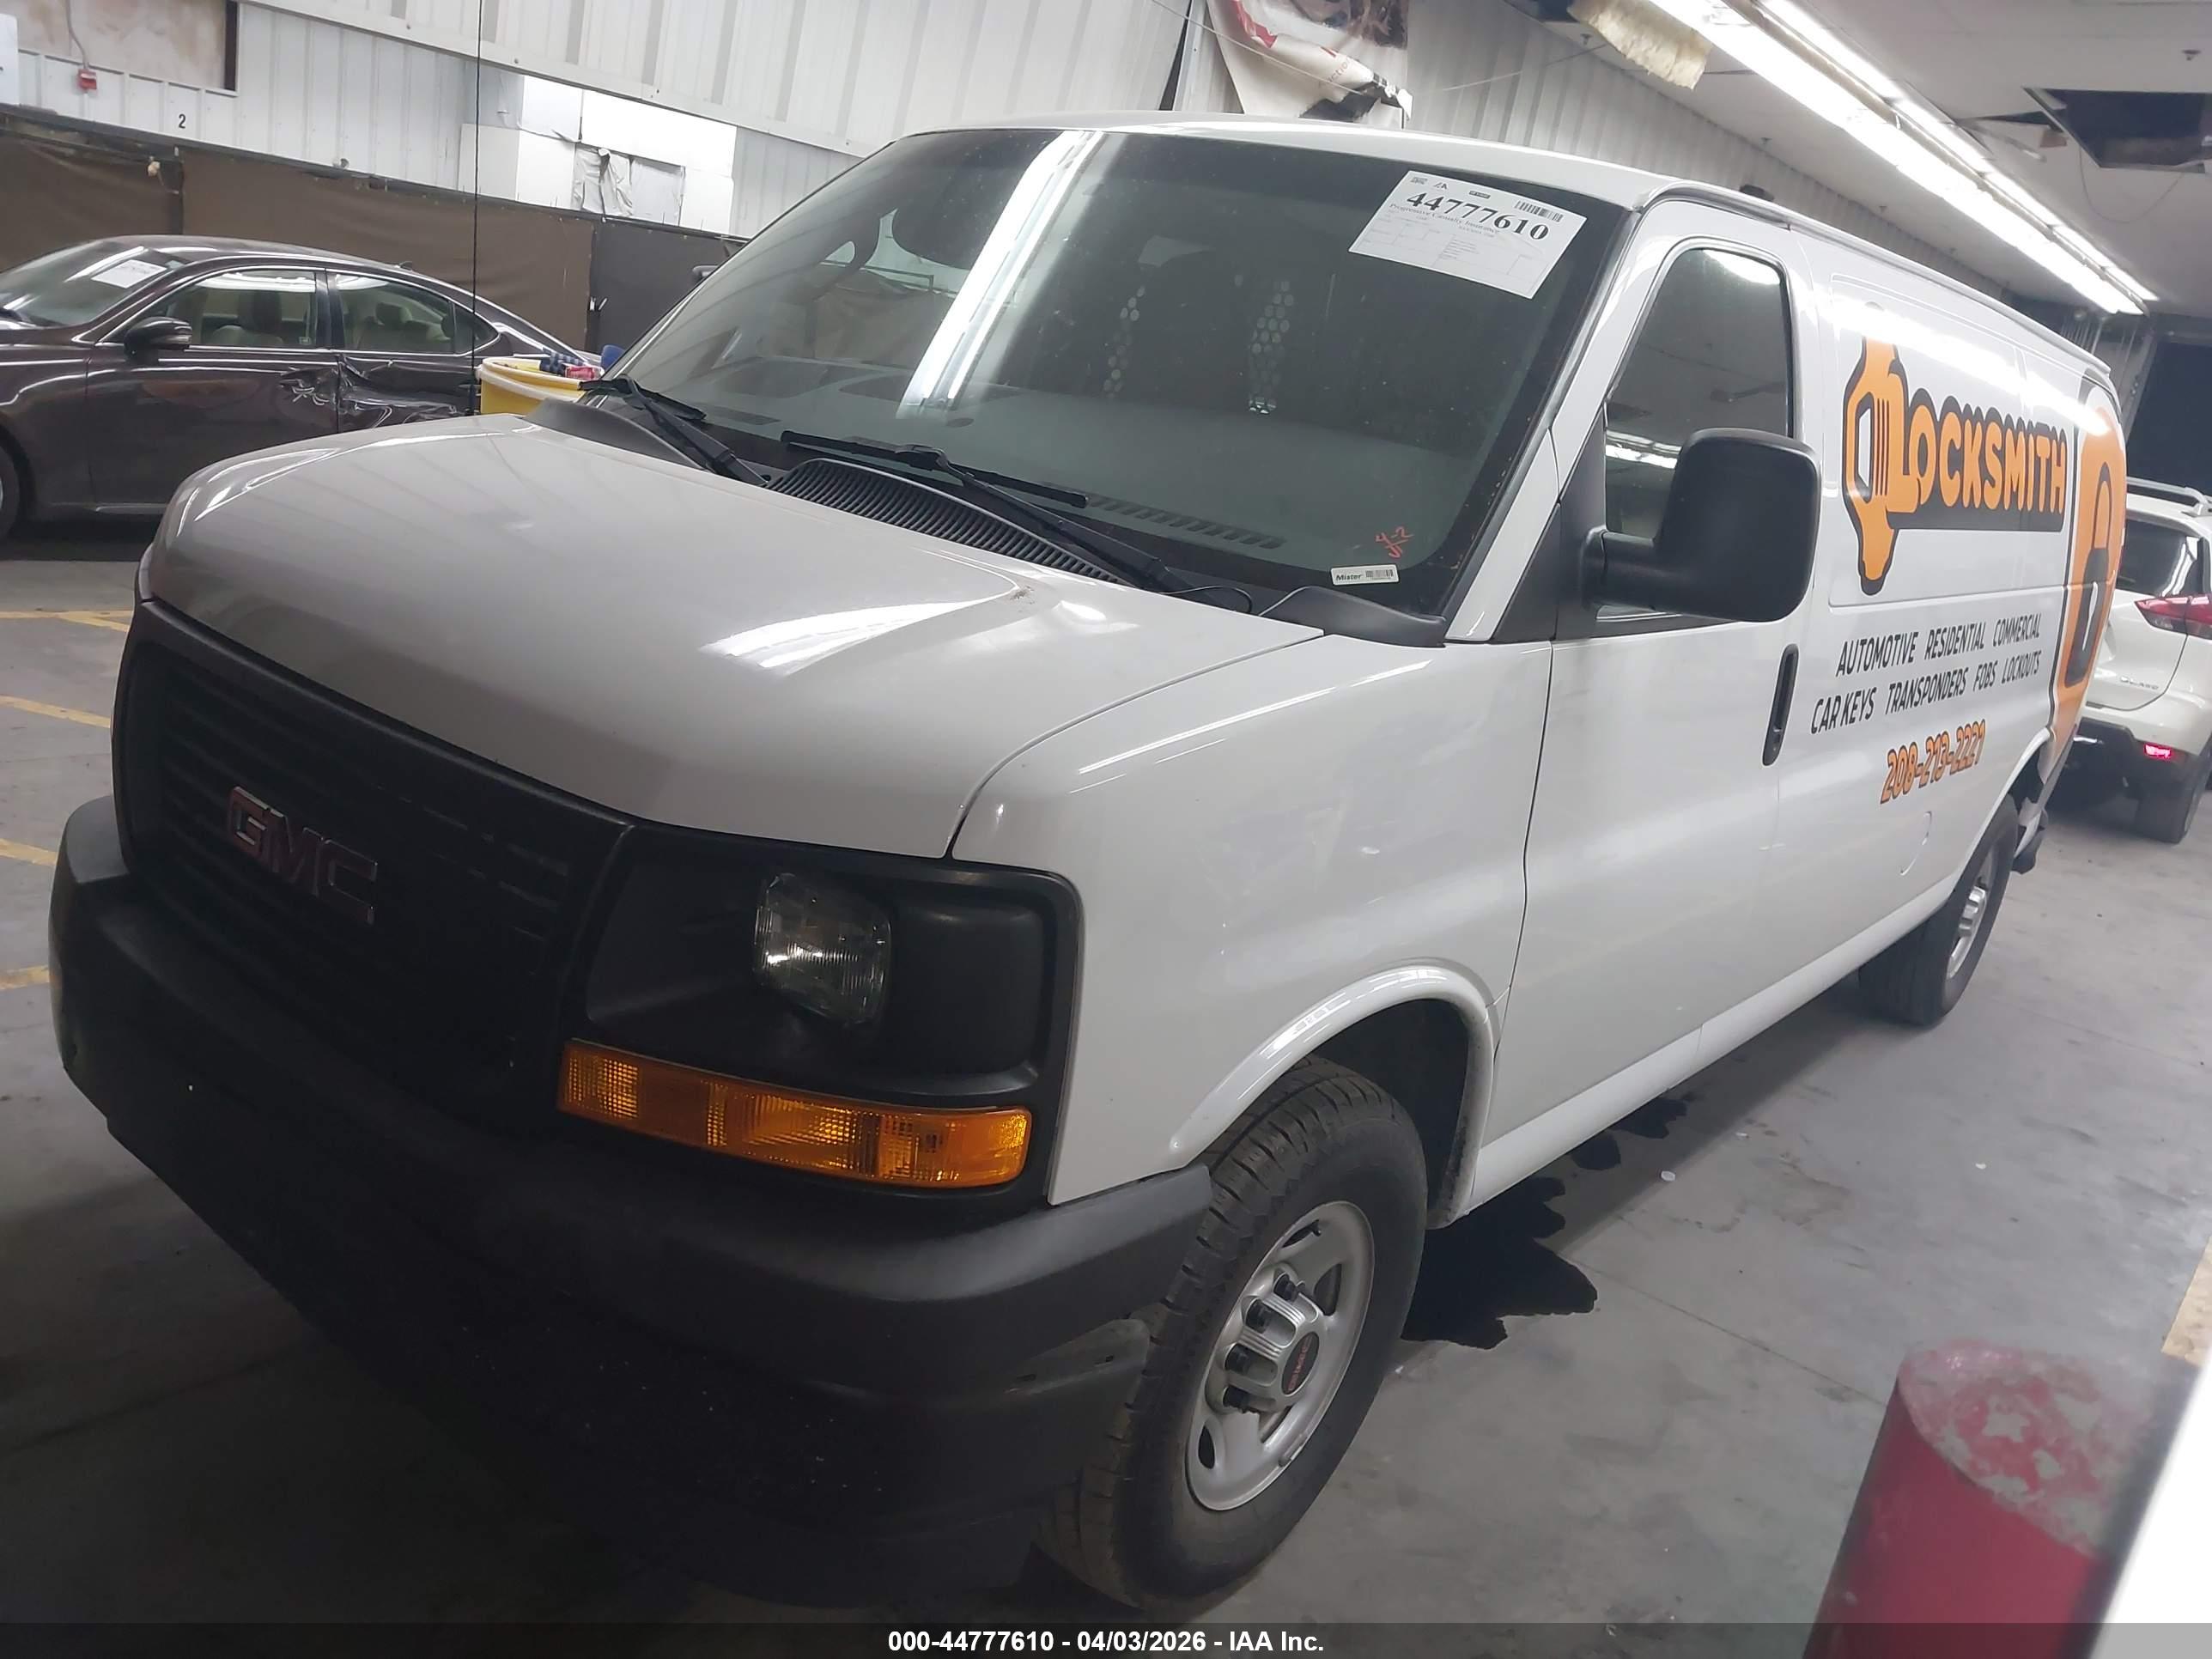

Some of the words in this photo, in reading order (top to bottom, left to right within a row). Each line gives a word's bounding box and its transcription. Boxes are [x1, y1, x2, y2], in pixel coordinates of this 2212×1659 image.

[179, 113, 186, 130] 2
[1407, 192, 1549, 240] 44777610
[1887, 372, 2067, 514] LOCKSMITH
[1835, 631, 1919, 678] AUTOMOTIVE
[1924, 622, 1986, 660] RESIDENTIAL
[1993, 613, 2041, 647] COMMERCIAL
[1885, 667, 1969, 714] TRANSPONDERS
[1973, 660, 1998, 692] FOBS
[2002, 650, 2042, 684] LOCKOUTS
[1880, 719, 1986, 805] 208-213-2221
[228, 786, 378, 926] GMC
